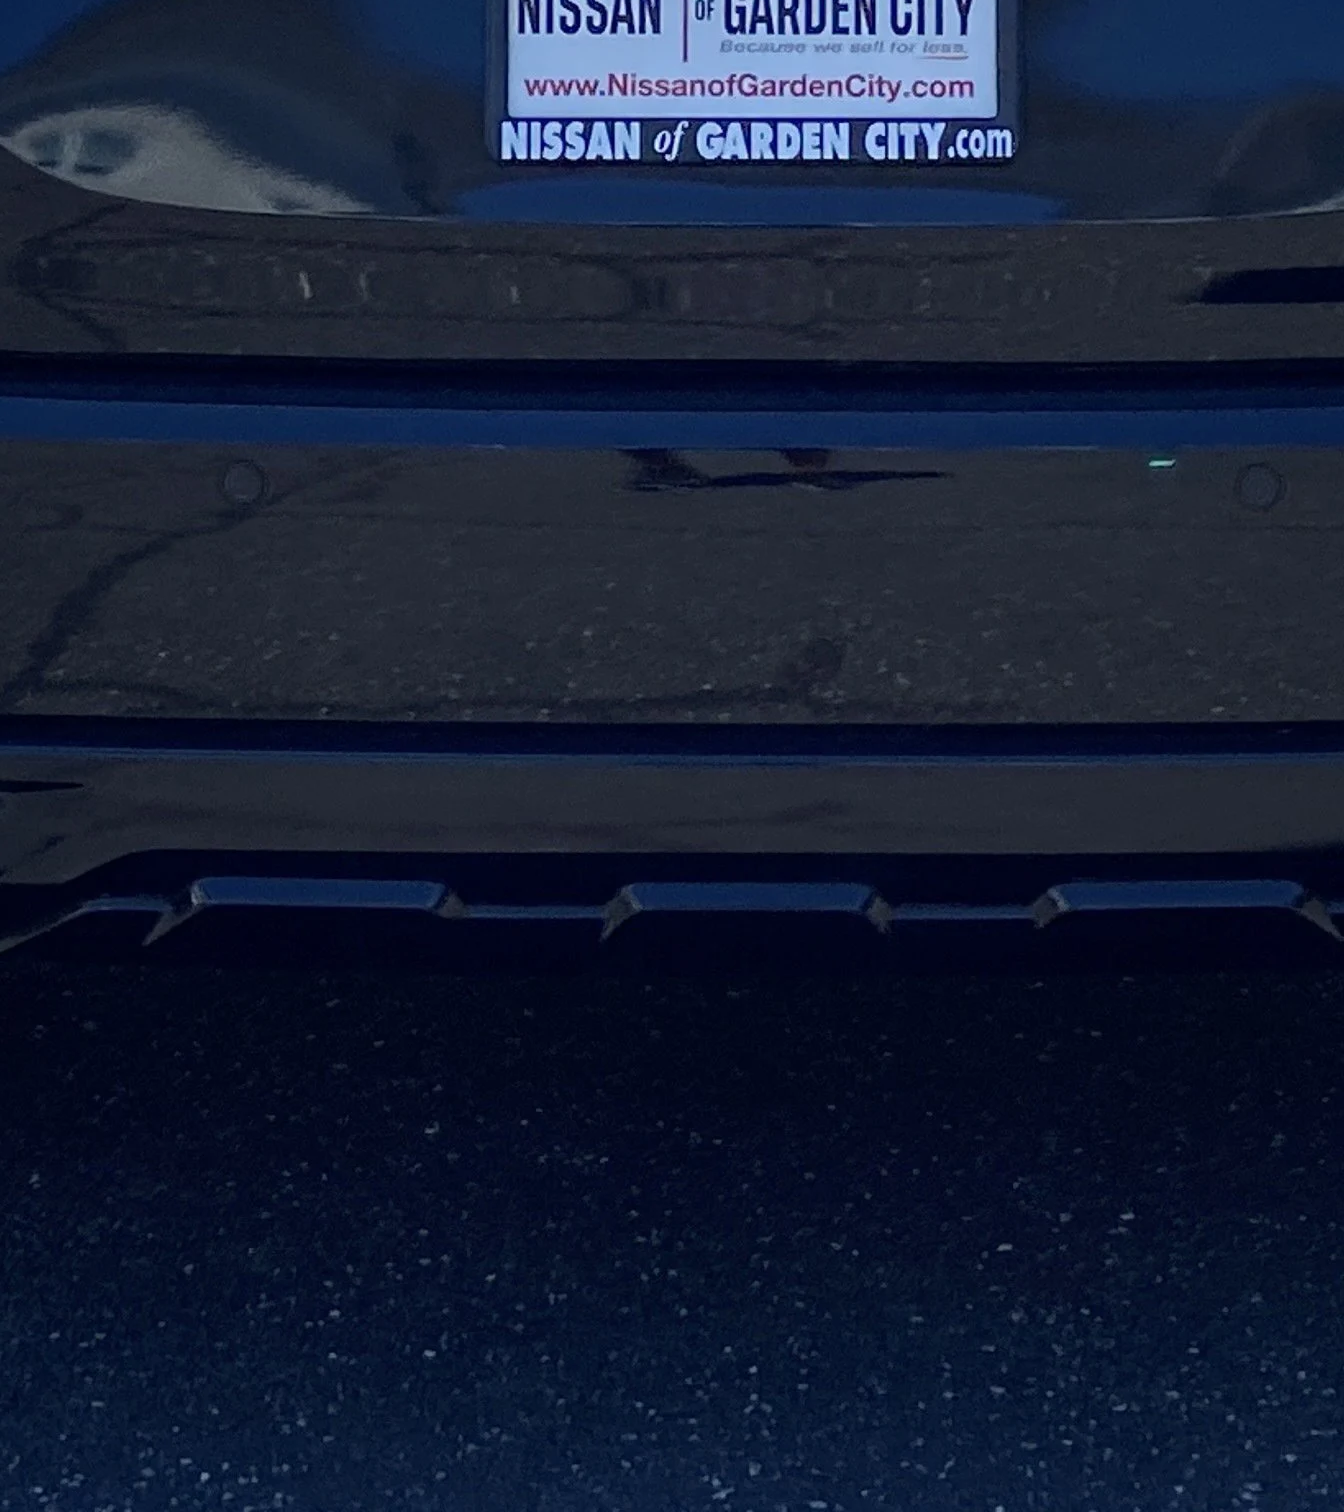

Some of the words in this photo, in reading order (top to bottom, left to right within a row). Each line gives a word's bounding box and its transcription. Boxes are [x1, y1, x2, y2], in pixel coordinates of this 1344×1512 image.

[720, 40, 807, 54] Because
[813, 43, 842, 54] we
[850, 40, 885, 54] sell
[890, 40, 916, 54] for
[524, 73, 975, 103] www.NissanofGardenCity.com
[500, 121, 642, 161] NISSAN
[653, 120, 689, 162] of
[696, 121, 850, 161] GARDEN
[864, 121, 1014, 161] CITY.com
